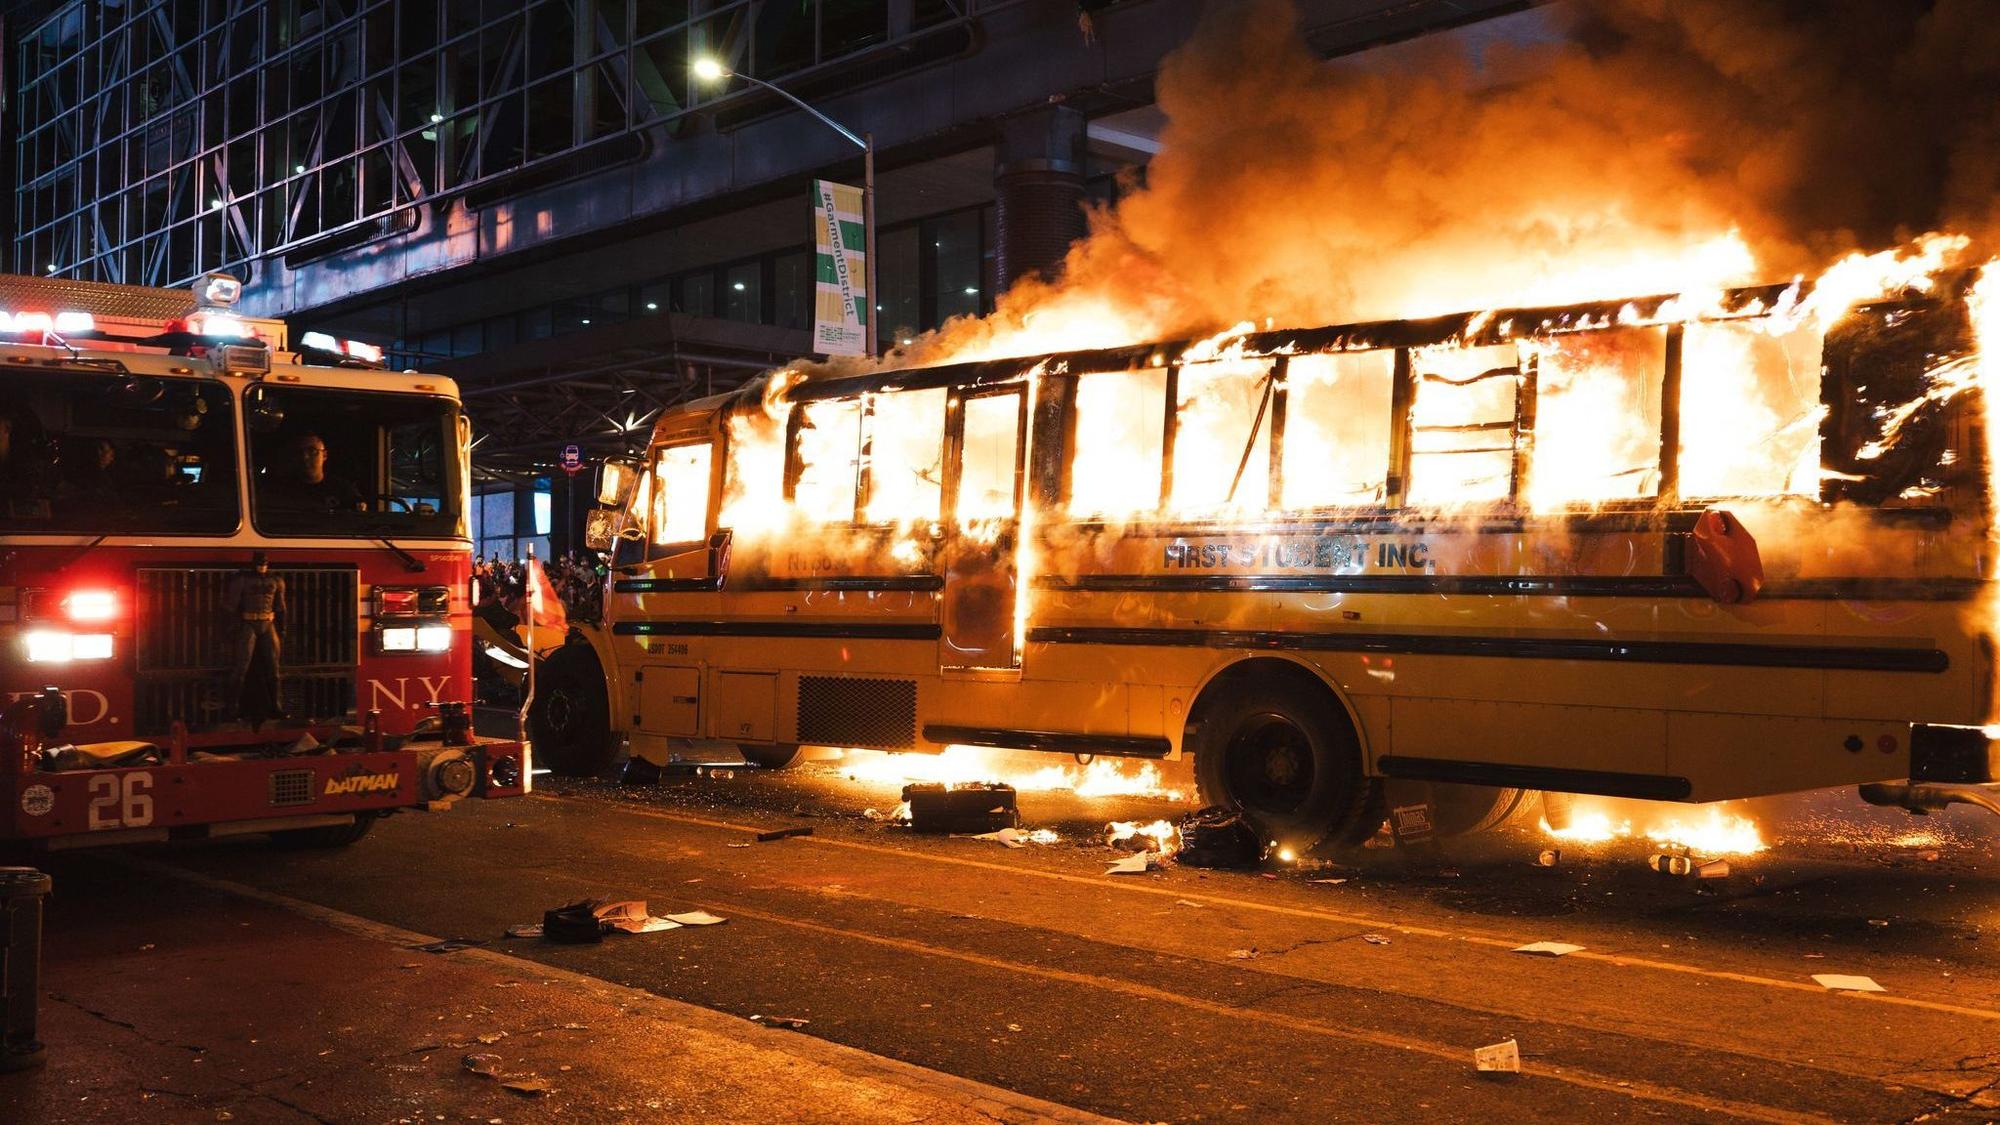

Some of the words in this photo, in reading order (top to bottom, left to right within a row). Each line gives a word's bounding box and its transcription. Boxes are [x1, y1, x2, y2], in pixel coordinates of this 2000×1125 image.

[823, 192, 855, 316] #GarmentDistrict
[1163, 543, 1232, 568] FIRST
[1378, 543, 1436, 568] INC.
[88, 771, 154, 830] 26
[324, 773, 399, 794] BATMAN
